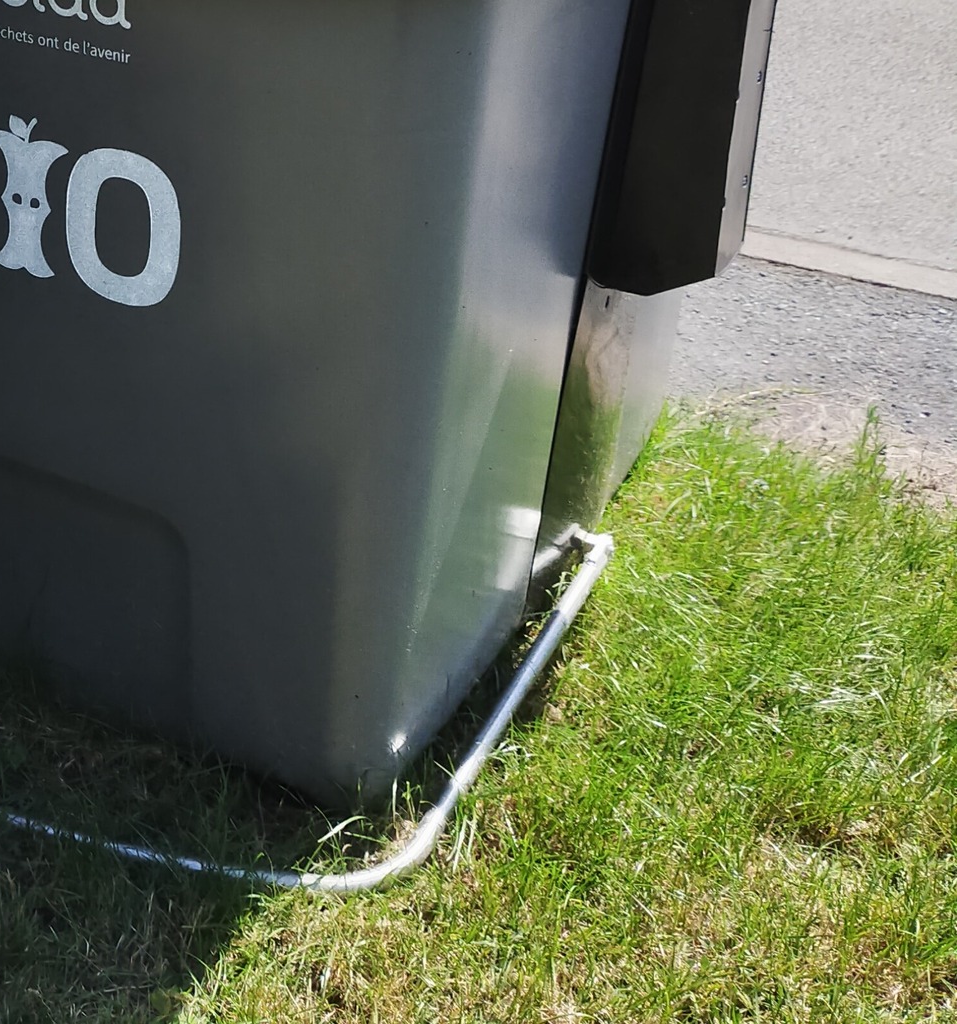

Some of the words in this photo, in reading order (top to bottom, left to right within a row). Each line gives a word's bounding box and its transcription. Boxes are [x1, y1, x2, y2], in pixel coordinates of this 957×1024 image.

[37, 36, 60, 50] ont
[63, 38, 80, 53] de
[83, 40, 131, 63] l'avenir
